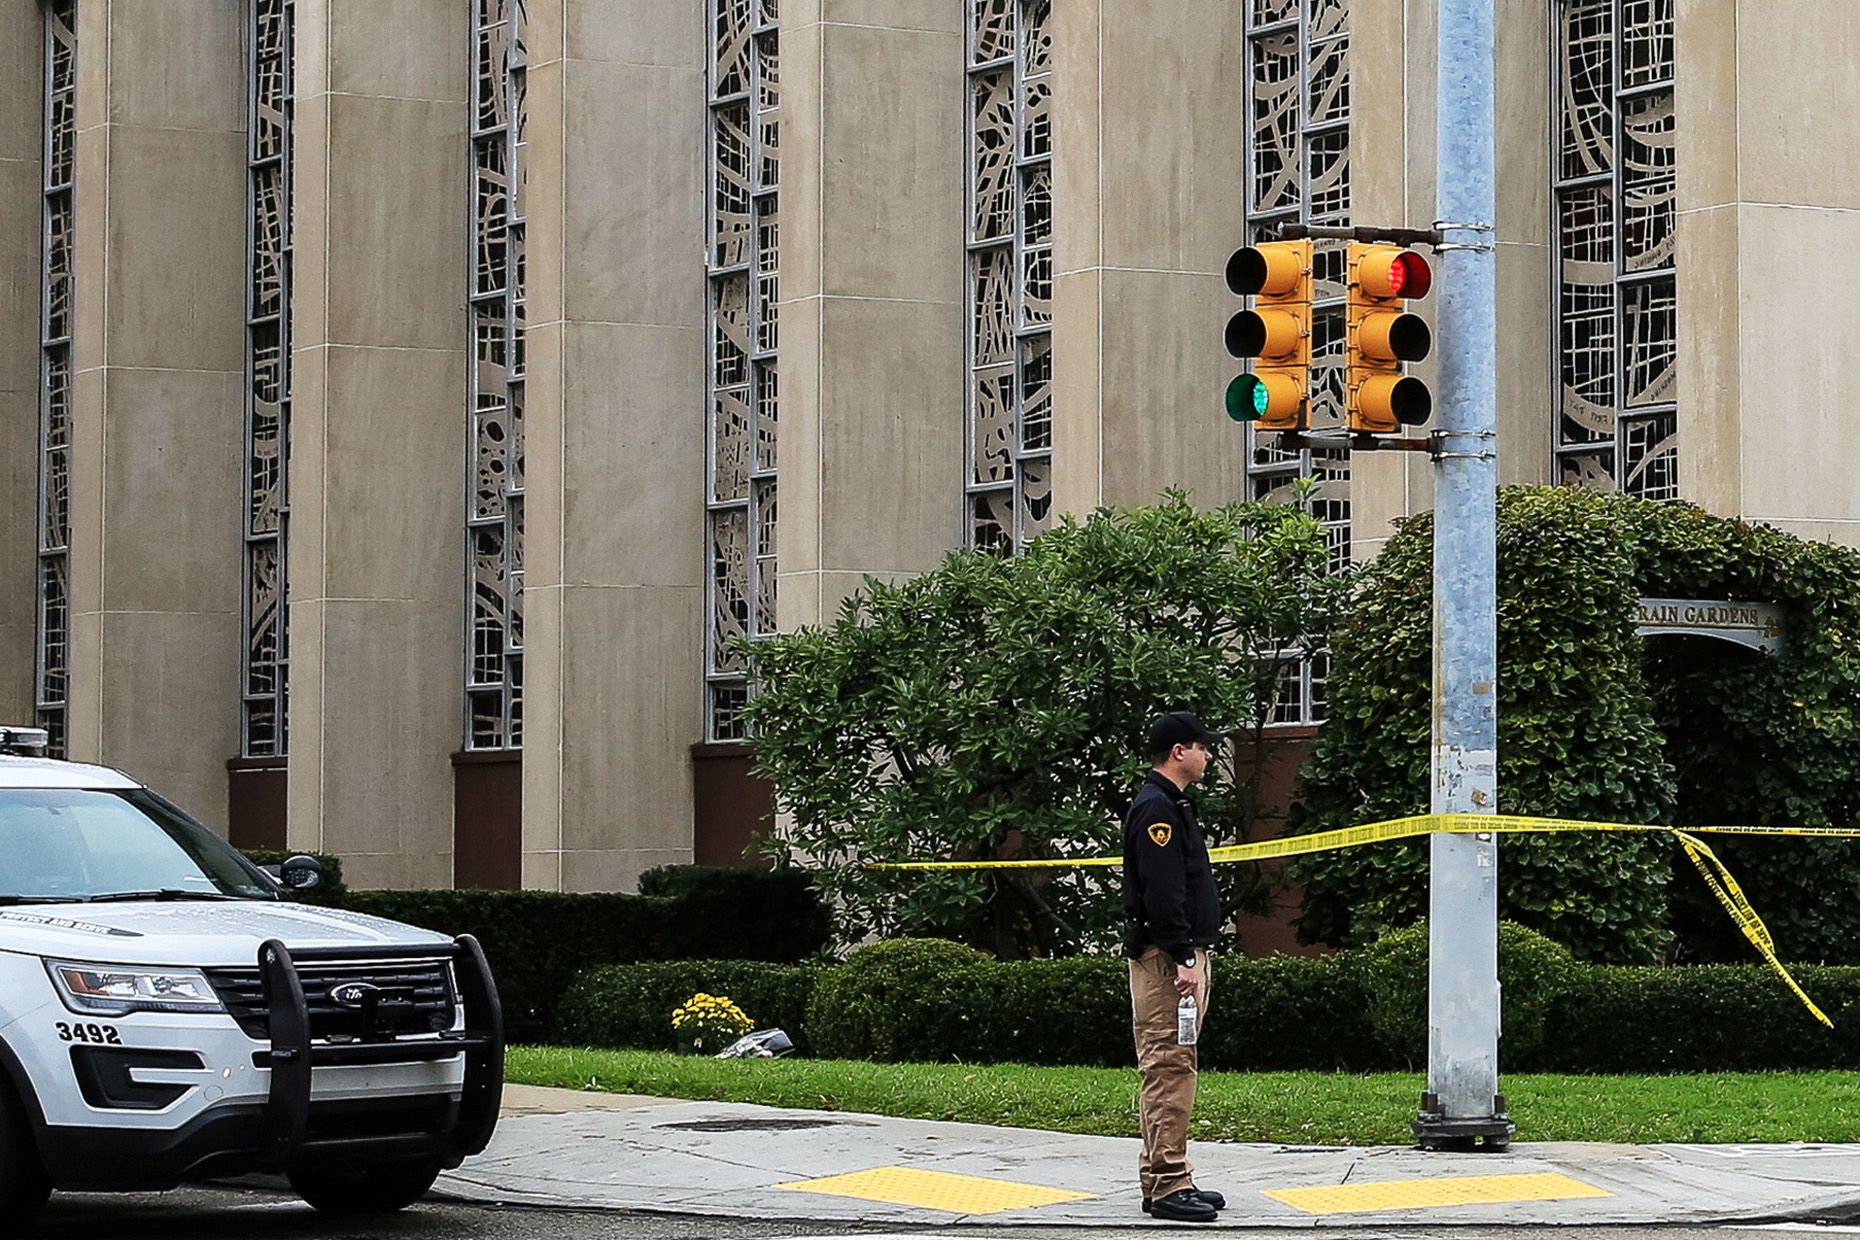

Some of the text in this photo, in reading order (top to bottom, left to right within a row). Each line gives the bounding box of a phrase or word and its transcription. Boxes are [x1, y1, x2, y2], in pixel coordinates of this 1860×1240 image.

[1638, 606, 1759, 625] RAIN GARDENS
[0, 911, 51, 924] PROTECT
[48, 918, 75, 929] AND
[56, 1022, 122, 1045] 3492
